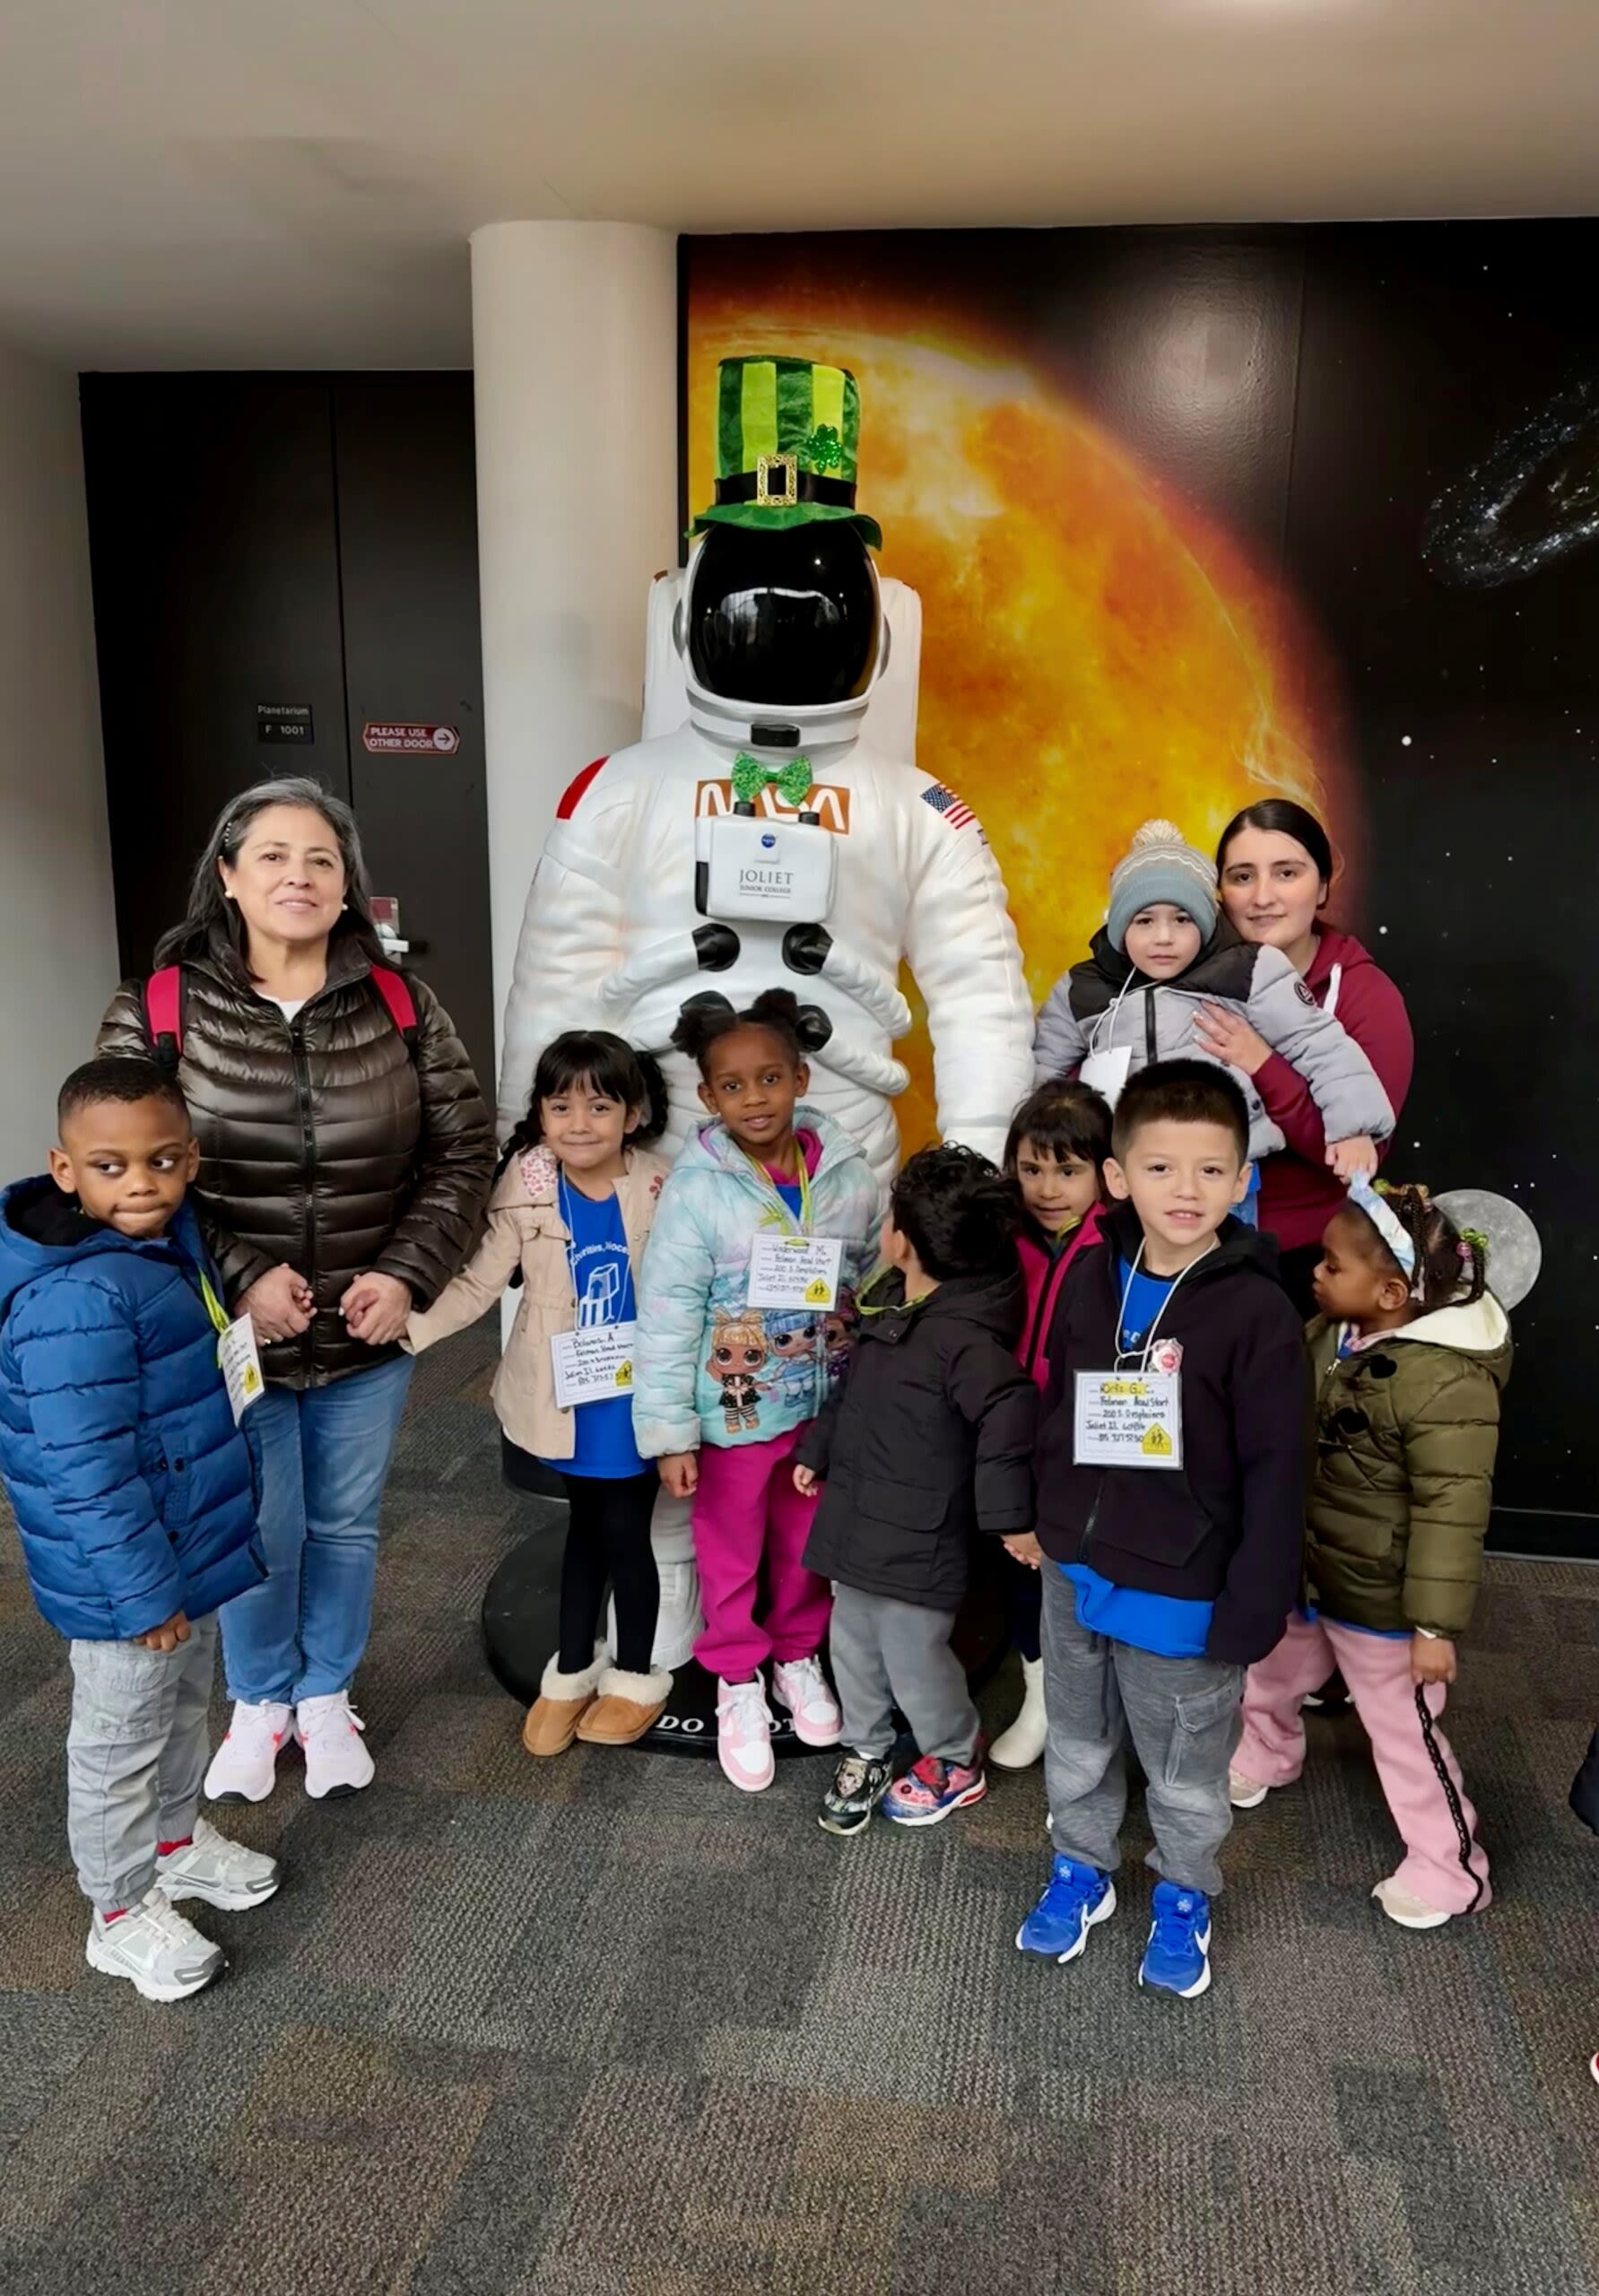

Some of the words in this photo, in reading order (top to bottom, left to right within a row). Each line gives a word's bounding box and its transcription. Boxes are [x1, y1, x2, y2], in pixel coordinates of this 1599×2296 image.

[257, 705, 309, 716] Planetarium
[265, 725, 273, 735] F
[280, 726, 304, 735] 1001
[370, 726, 406, 736] PLEASE
[408, 727, 427, 737] USE
[369, 737, 403, 748] OTHER
[404, 739, 434, 749] DOOR
[739, 869, 795, 884] JOLIET
[739, 883, 763, 892] JUNIOR
[764, 884, 791, 893] COLLEGE
[656, 1715, 705, 1733] DO
[769, 1718, 795, 1734] OT
